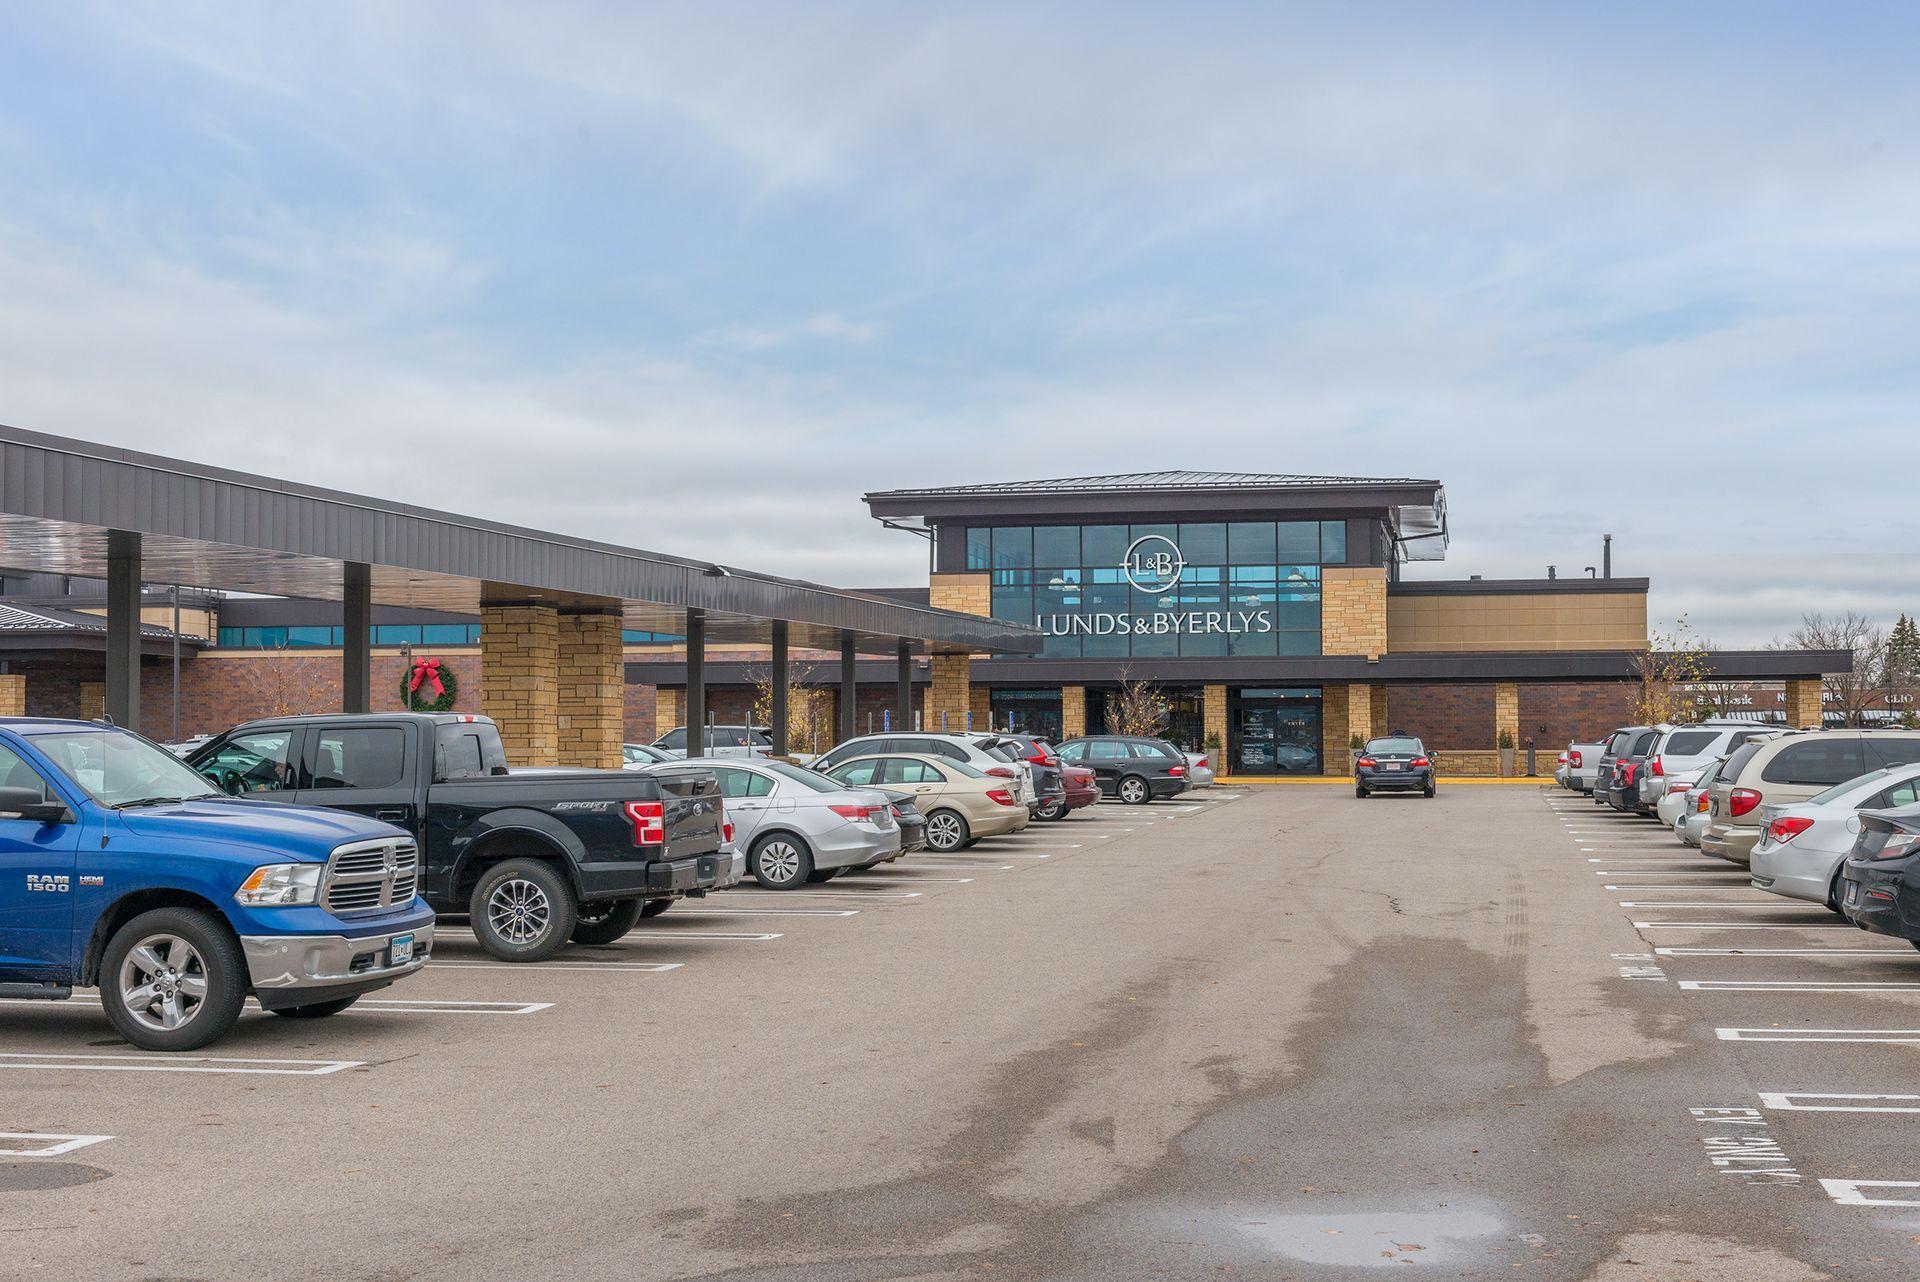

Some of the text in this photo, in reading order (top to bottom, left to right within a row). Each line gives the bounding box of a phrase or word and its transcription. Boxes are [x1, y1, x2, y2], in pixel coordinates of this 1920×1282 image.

[1133, 552, 1173, 576] L&B
[550, 801, 615, 810] SPORT
[27, 874, 70, 884] RAM
[27, 883, 70, 893] 1500
